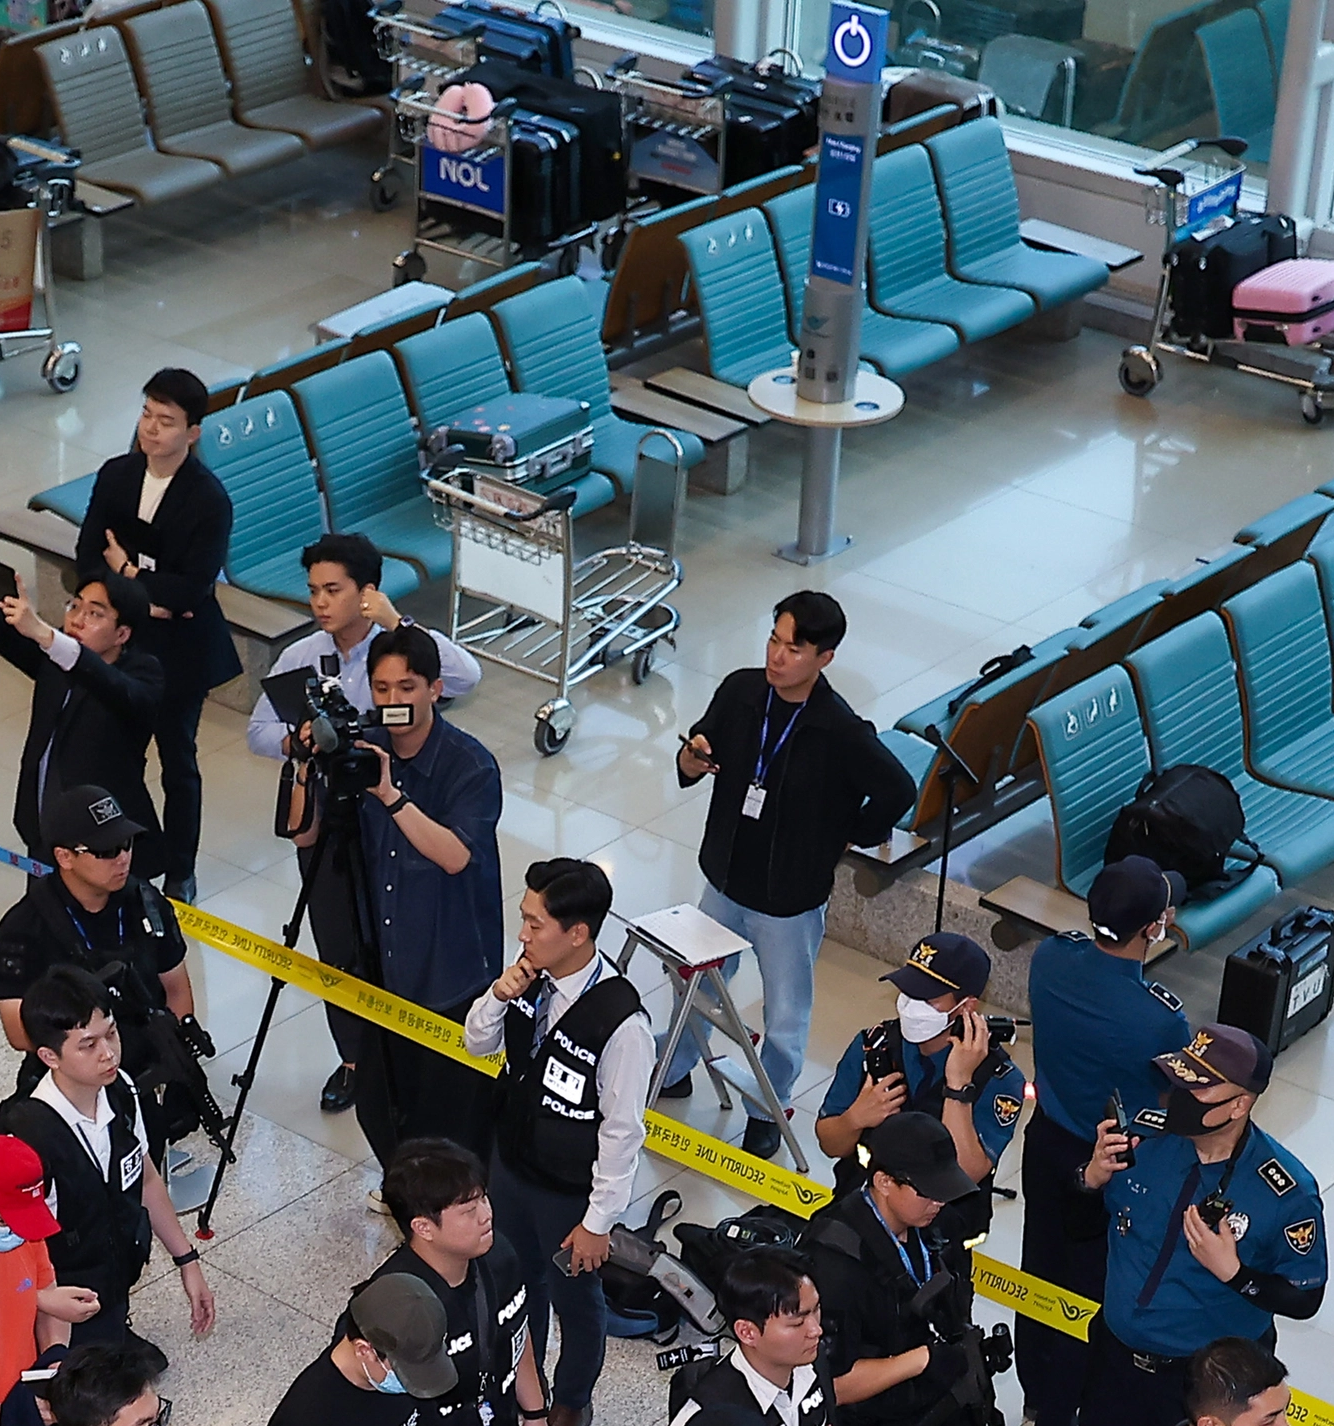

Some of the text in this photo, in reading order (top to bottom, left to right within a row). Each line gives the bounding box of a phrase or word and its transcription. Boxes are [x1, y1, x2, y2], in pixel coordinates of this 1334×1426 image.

[440, 157, 490, 192] NOL
[554, 1029, 596, 1067] POLICE
[541, 1094, 596, 1121] POLICE
